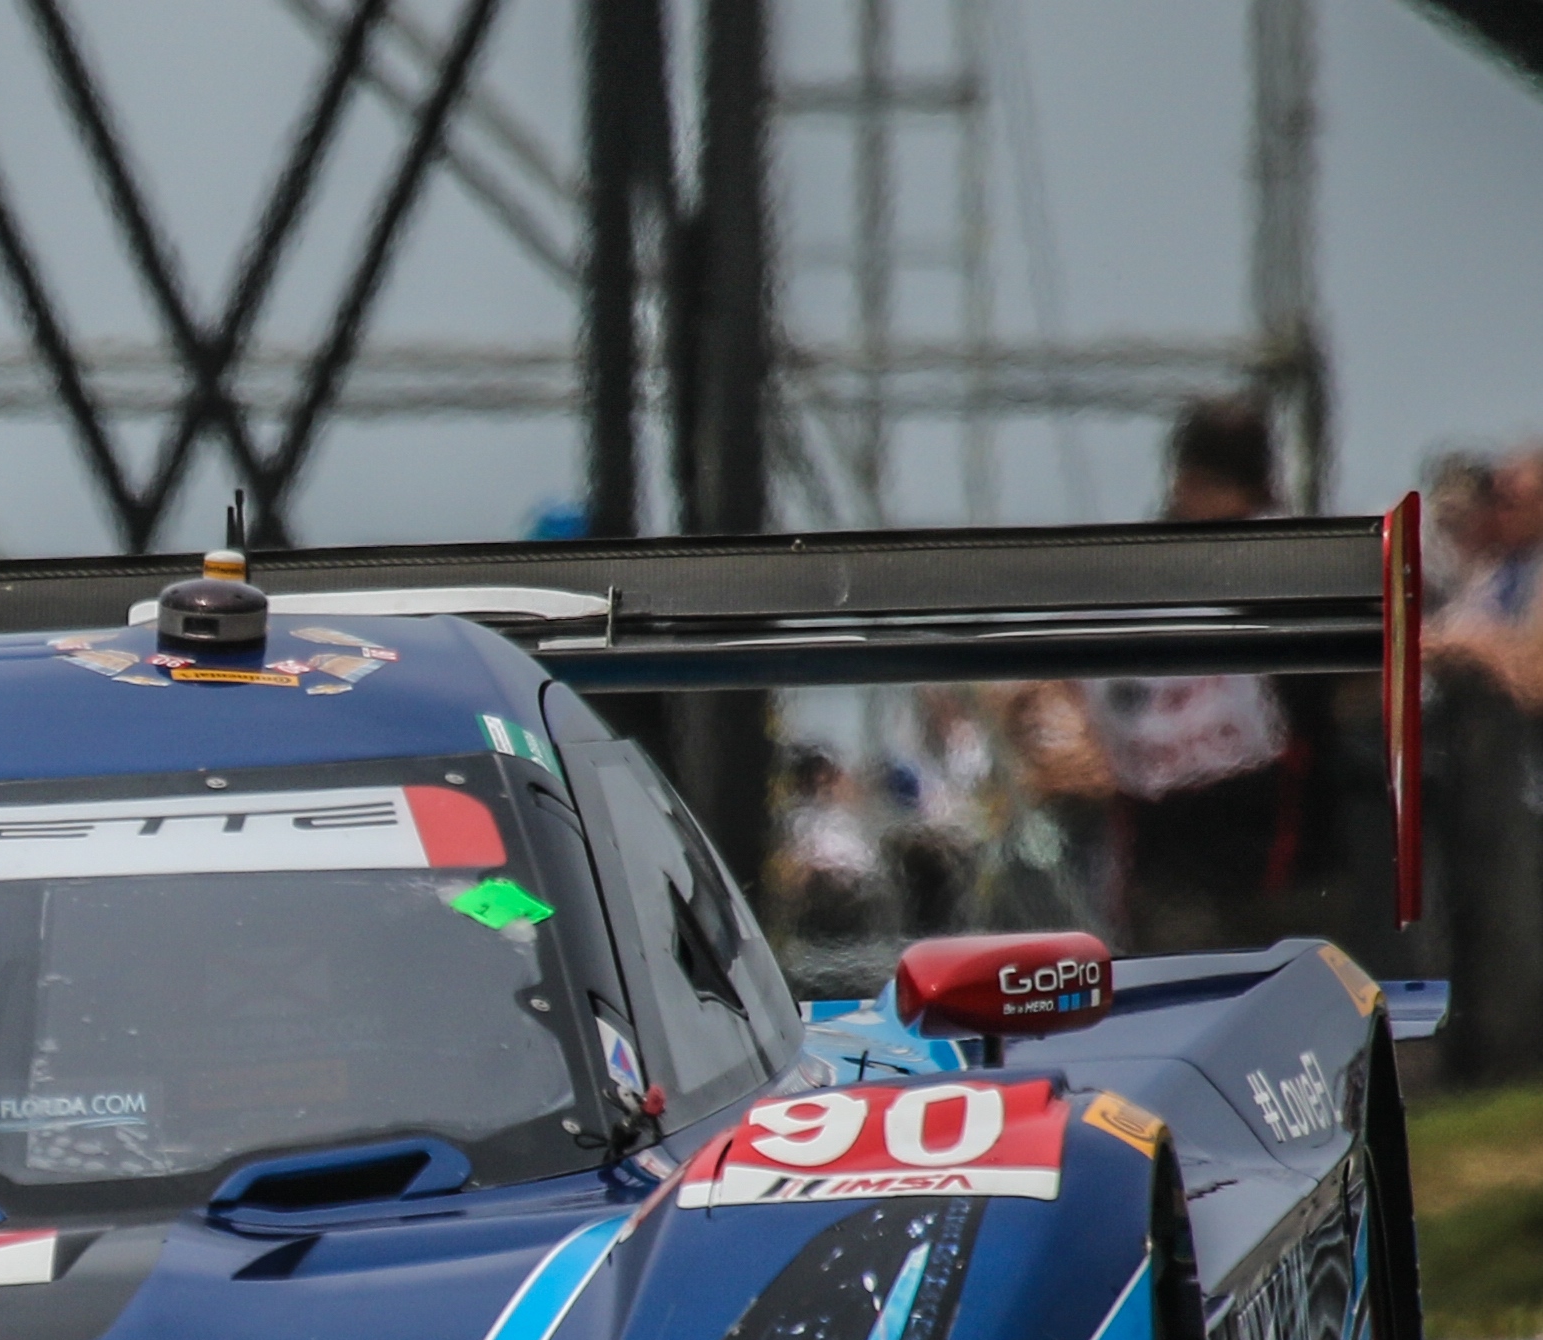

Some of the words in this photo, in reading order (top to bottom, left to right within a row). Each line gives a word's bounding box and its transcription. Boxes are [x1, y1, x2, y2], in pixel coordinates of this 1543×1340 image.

[999, 959, 1101, 995] GoPro
[749, 1084, 1004, 1167] 90
[828, 1174, 974, 1194] IMSA
